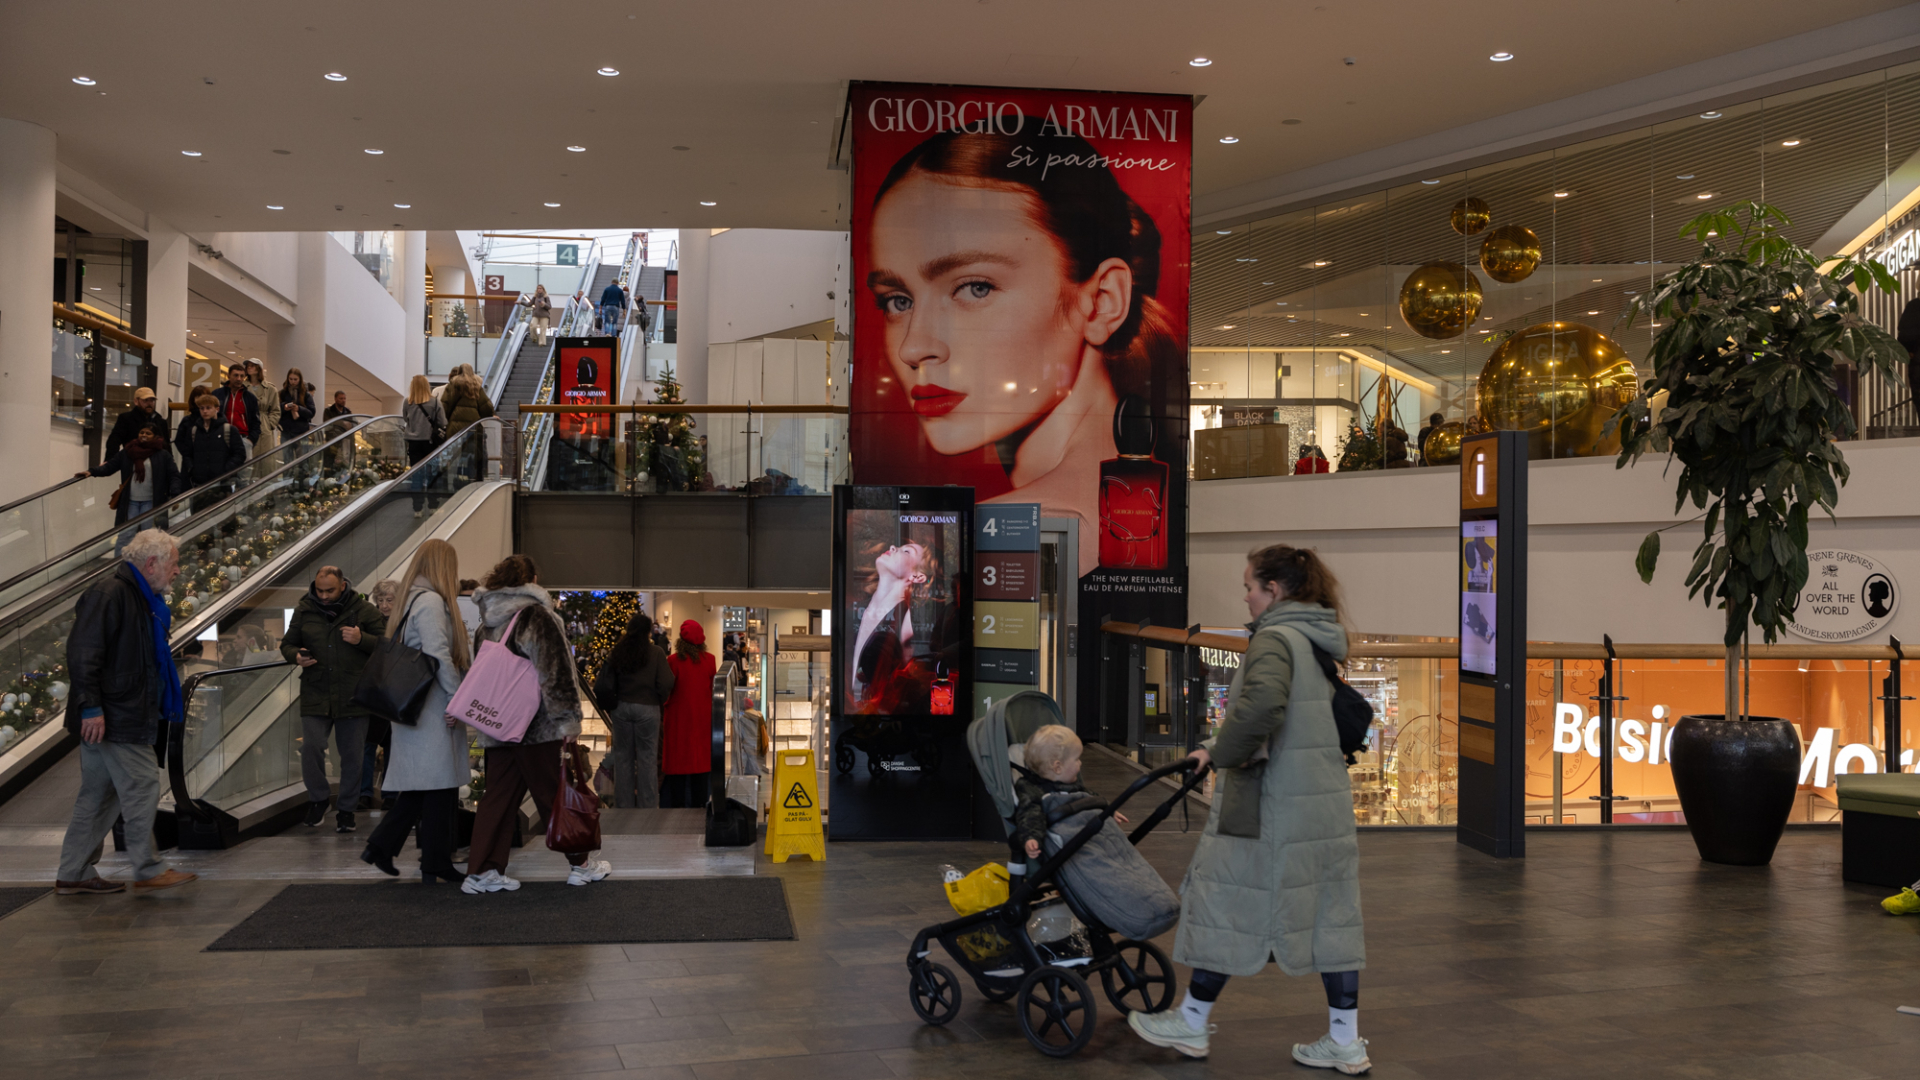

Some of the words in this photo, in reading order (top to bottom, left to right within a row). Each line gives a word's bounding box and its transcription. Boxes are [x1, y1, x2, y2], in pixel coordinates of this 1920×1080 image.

[868, 97, 1025, 136] GIORGIO
[1038, 104, 1179, 143] ARMANI
[1006, 145, 1039, 169] Sì
[1042, 151, 1176, 181] passione
[560, 247, 575, 263] 4
[488, 276, 500, 291] 3
[191, 362, 213, 388] 2
[1234, 412, 1264, 420] BLACK
[900, 515, 928, 523] GIORGIO
[930, 516, 956, 524] ARMANI
[982, 518, 998, 537] 4
[1808, 551, 1834, 562] RENE
[1836, 551, 1874, 570] GRENES
[982, 566, 996, 586] 3
[1092, 574, 1106, 582] THE
[1109, 575, 1128, 583] NEW
[1132, 576, 1174, 584] REFILLABLE
[1084, 584, 1099, 592] EAU
[1102, 584, 1112, 592] DE
[1114, 584, 1146, 592] PARFUM
[1148, 585, 1182, 594] INTENSE
[1822, 582, 1838, 591] ALL
[1806, 594, 1832, 603] OVER
[1838, 594, 1856, 603] THE
[1812, 606, 1849, 615] WORLD
[982, 614, 996, 634] 2
[470, 699, 499, 718] Basic
[983, 696, 992, 712] 1
[465, 709, 476, 718] &
[475, 714, 503, 730] More
[1794, 727, 1920, 788] Mo
